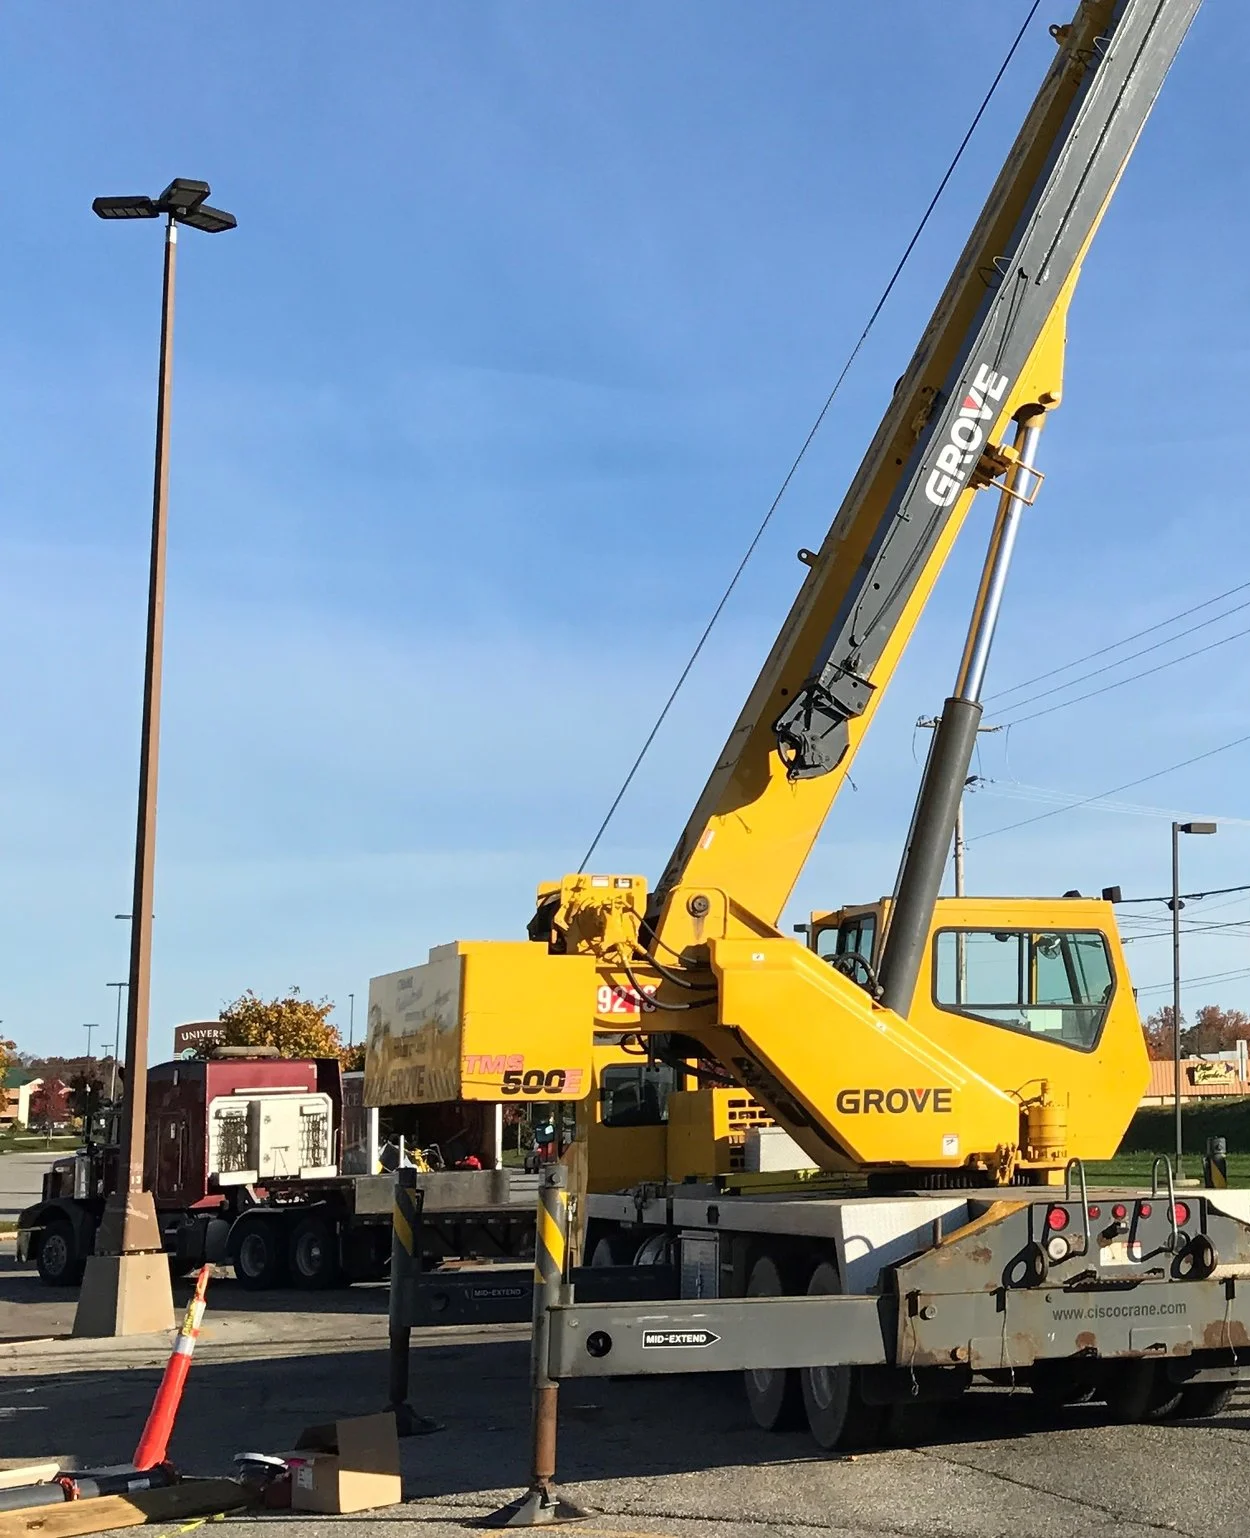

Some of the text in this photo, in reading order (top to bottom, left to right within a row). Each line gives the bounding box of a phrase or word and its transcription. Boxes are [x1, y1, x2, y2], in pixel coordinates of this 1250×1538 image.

[925, 363, 1009, 507] GROVE
[465, 1054, 525, 1075] TMS
[836, 1088, 953, 1114] GROVE
[1052, 1302, 1187, 1320] www.ciscocrane.com
[646, 1334, 707, 1344] MID-EXTEND
